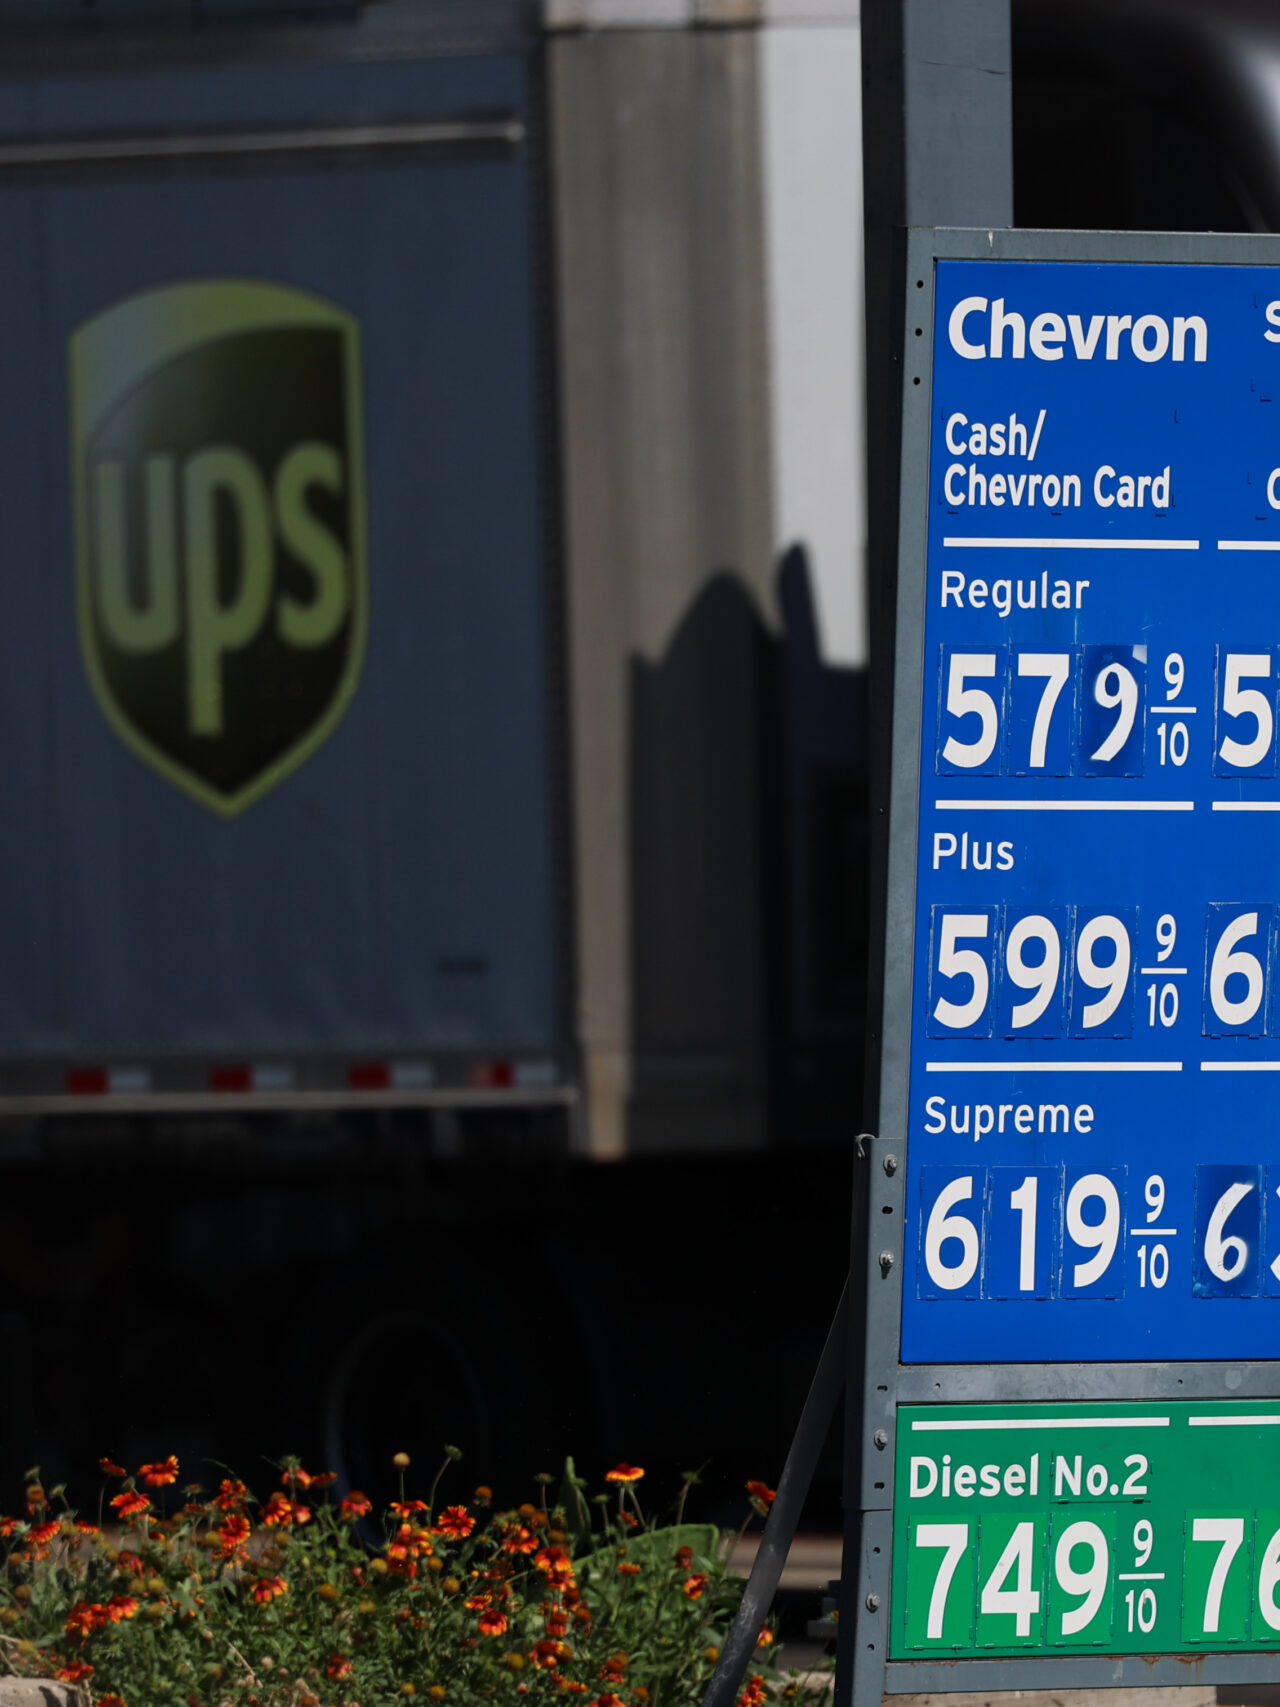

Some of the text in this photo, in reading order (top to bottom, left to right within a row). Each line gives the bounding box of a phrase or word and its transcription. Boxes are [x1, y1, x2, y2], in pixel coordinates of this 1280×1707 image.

[948, 296, 1208, 363] Chevron
[945, 409, 1047, 461] Cash/
[944, 463, 1171, 509] Chevron Card
[94, 440, 349, 735] ups
[941, 570, 1090, 618] Regular
[942, 653, 1138, 768] 579
[933, 831, 1014, 871] Plus
[933, 914, 1131, 1029] 599
[924, 1095, 1095, 1143] Supreme
[925, 1173, 1121, 1291] 619
[909, 1452, 1148, 1498] Diesel No.2
[915, 1520, 1109, 1639] 749
